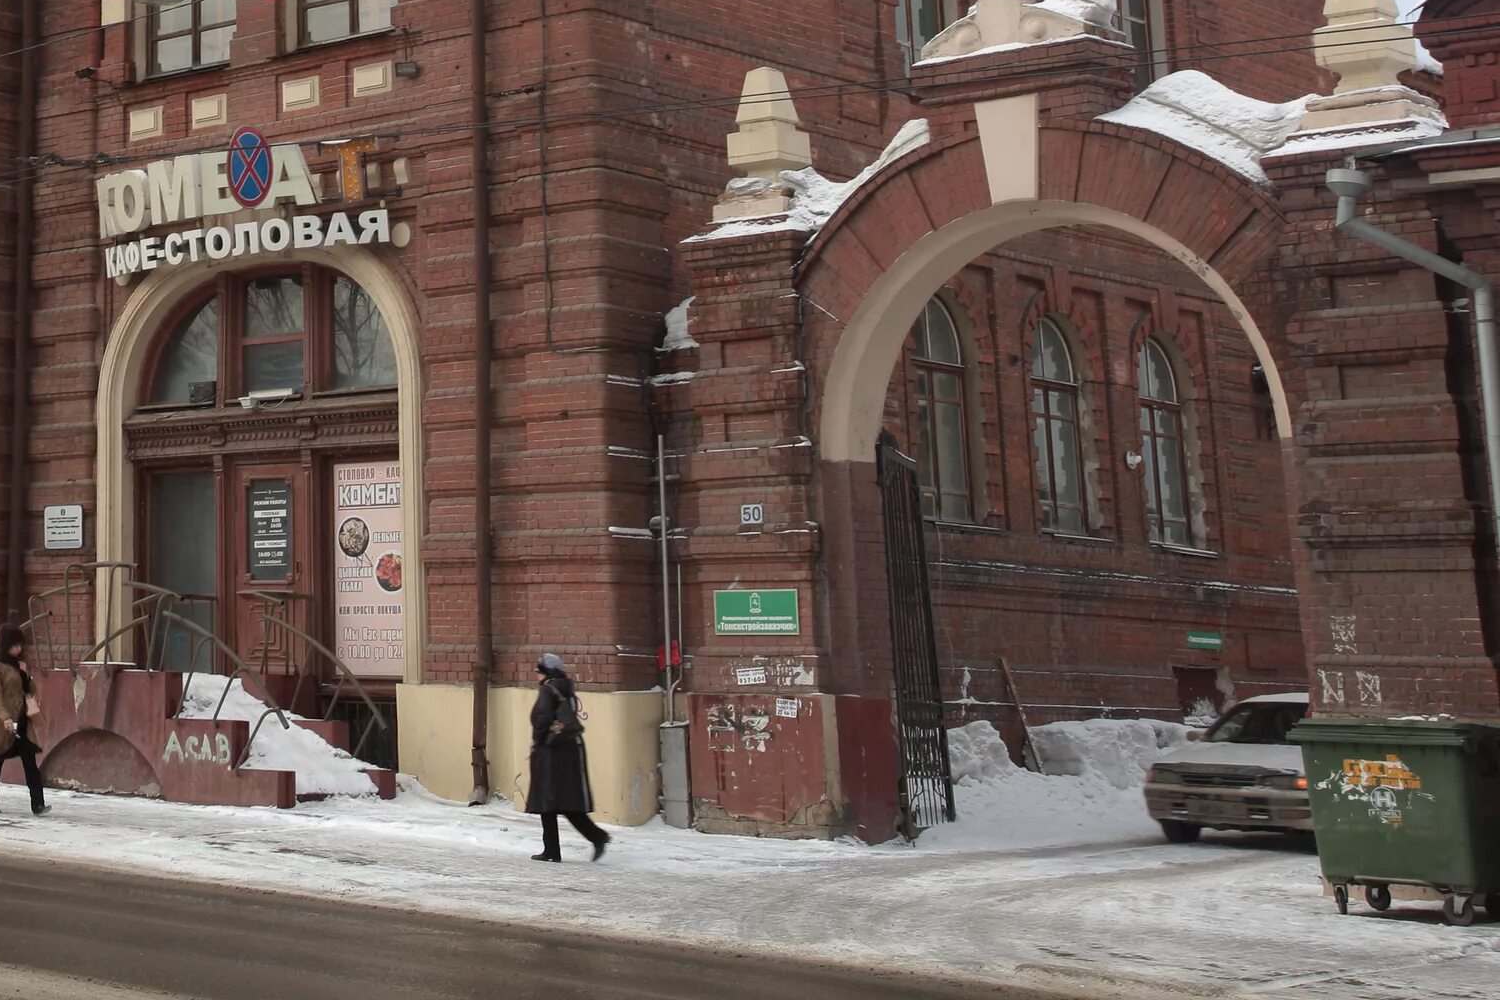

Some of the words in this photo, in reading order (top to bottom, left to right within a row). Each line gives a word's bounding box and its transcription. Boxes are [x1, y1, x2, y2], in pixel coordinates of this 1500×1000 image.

[105, 209, 390, 279] КАФЕ-СТОЛОВАЯ
[338, 468, 375, 481] СТОЛОВАЯ
[743, 506, 761, 522] 50
[338, 581, 363, 592] ТАБАКА
[353, 605, 374, 614] ПРОСТО
[343, 627, 359, 641] Мы
[362, 627, 377, 641] Вас
[348, 644, 371, 659] 10.00
[374, 646, 384, 662] до
